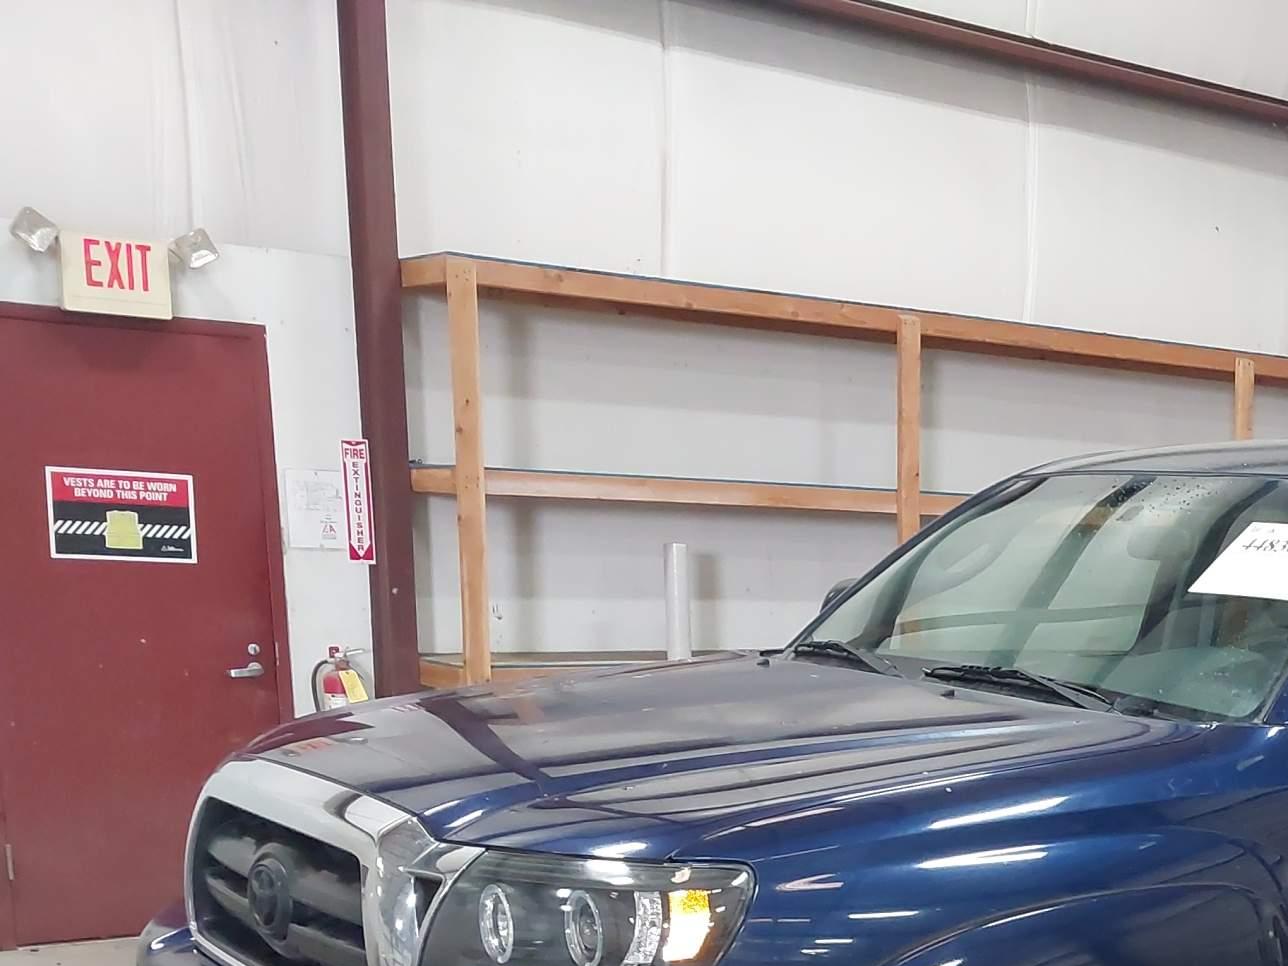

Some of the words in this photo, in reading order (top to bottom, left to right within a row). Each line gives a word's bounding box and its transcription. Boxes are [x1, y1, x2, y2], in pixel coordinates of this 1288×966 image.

[83, 238, 151, 292] EXIT
[344, 447, 366, 460] FIRE
[63, 476, 95, 488] VESTS
[96, 478, 116, 489] ARE
[117, 479, 130, 490] TO
[132, 480, 145, 490] BE
[146, 482, 177, 492] WORN
[74, 487, 114, 498] BEYOND
[115, 490, 138, 500] THIS
[139, 491, 168, 502] POINT
[351, 461, 365, 552] EXTINGUISHER
